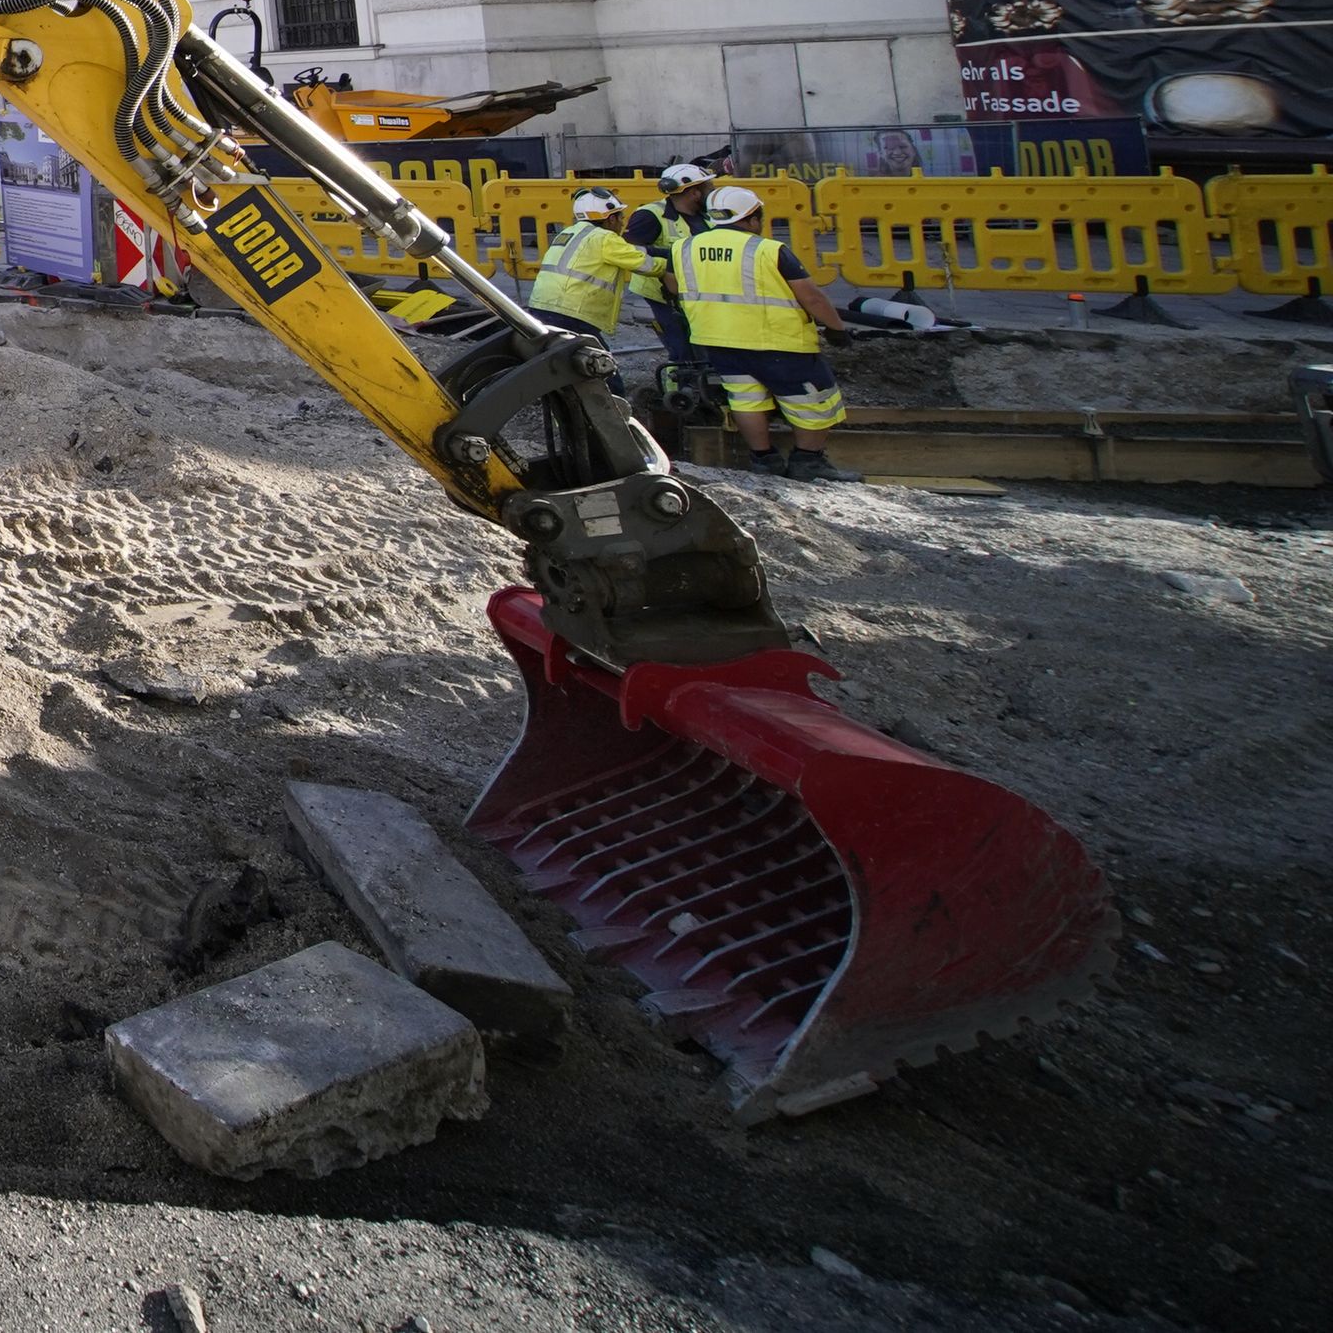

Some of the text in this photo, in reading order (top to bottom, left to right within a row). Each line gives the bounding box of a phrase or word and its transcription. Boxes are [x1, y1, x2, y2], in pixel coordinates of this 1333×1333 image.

[991, 58, 1025, 81] als
[980, 90, 1082, 113] Fassade
[215, 203, 304, 288] PORR
[699, 247, 733, 262] PORR
